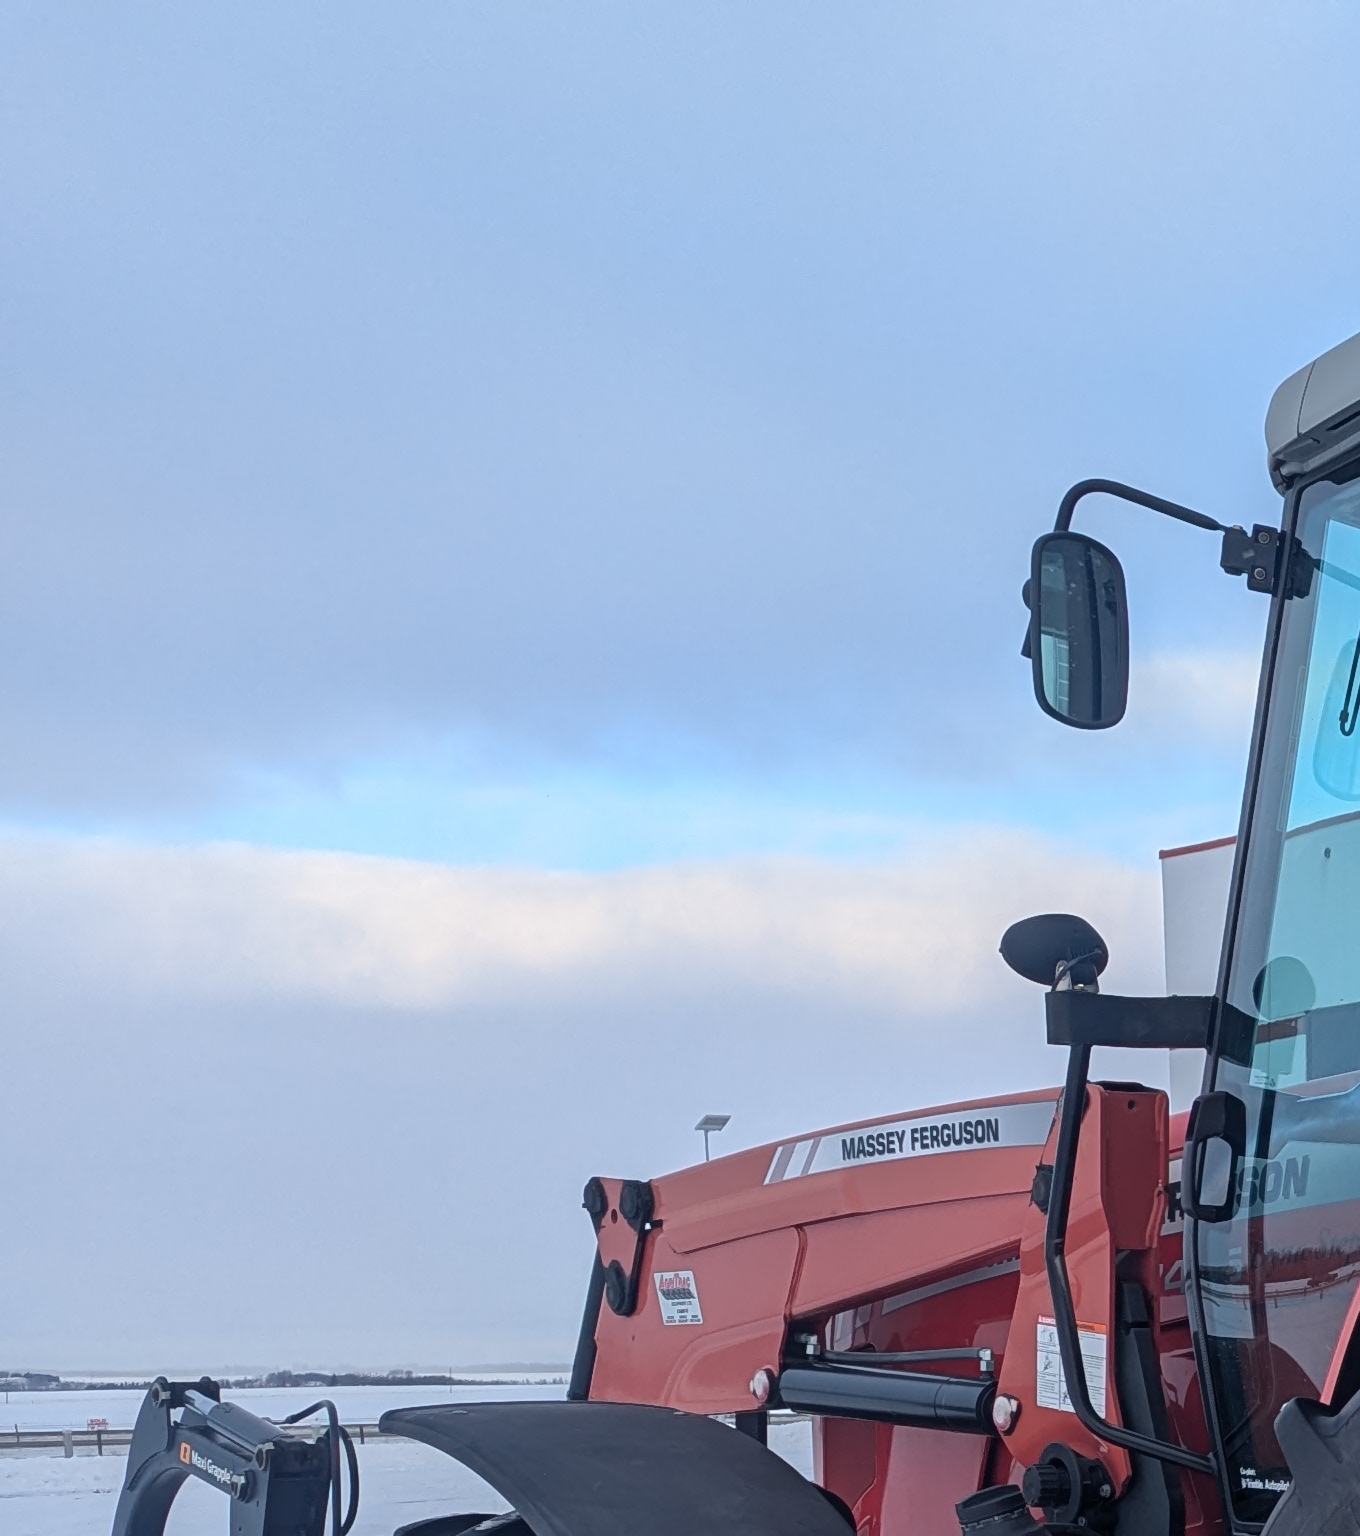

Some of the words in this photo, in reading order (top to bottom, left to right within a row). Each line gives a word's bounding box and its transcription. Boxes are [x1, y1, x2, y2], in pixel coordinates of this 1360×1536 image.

[841, 1129, 906, 1161] MASSEY
[910, 1118, 1000, 1152] FERGUSON
[191, 1449, 207, 1470] Maxi
